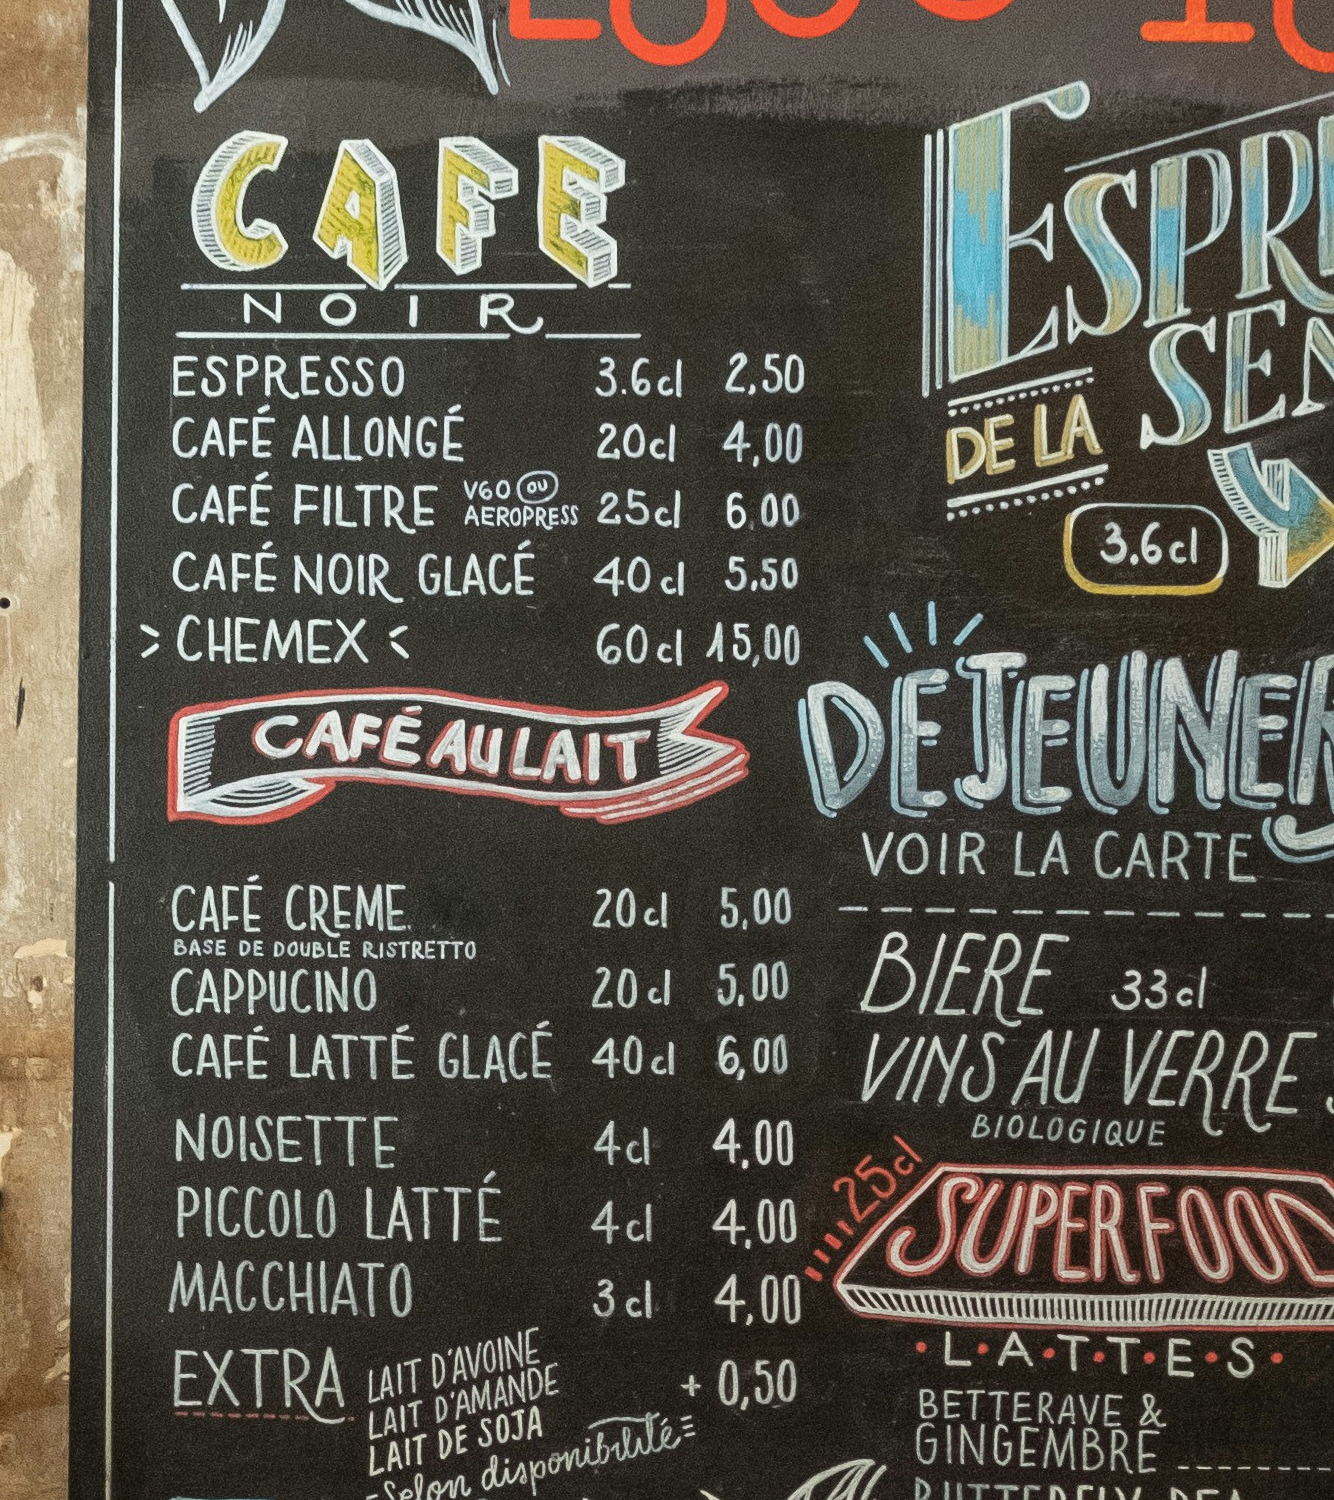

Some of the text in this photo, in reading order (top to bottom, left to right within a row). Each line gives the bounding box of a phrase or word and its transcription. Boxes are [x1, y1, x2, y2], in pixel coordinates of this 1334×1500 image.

[191, 130, 626, 289] CAFE
[243, 294, 542, 334] NOIR
[172, 355, 405, 398] ESPRESSO
[725, 353, 805, 395] 2,50
[172, 406, 274, 460] CAFÉ
[293, 404, 465, 462] ALLONGÉ
[723, 421, 803, 466] 4,00
[947, 413, 1015, 485] DE
[1034, 395, 1101, 464] LA
[172, 473, 437, 532] CAFÉ FILTRE
[465, 480, 510, 500] V60
[465, 505, 579, 529] AEROPRESS
[173, 541, 535, 602] CAFÉ NOIR GLACÉ
[178, 616, 800, 664] CHEMEX 15,00
[255, 706, 651, 784] CAFÉ AU LAIT
[863, 830, 1255, 882] VOIR LA CARTE
[171, 876, 263, 932] CAFÉ
[173, 939, 477, 959] BASE DE DOUBLE RISTRETTO
[171, 968, 377, 1015] CAPPUCINO
[861, 932, 1069, 1026] BIERE
[171, 1021, 789, 1082] CAFÉ LATTÉ GLACÉ 6,00
[862, 1030, 1317, 1135] VINS AU VERRE
[176, 1114, 398, 1168] NOISETTE
[972, 1115, 1165, 1146] BIOLOGIQUE
[176, 1171, 502, 1242] PICCOLO LATTÉ
[169, 1261, 412, 1318] MACCHIATO
[173, 1348, 345, 1423] EXTRA
[369, 1328, 540, 1404] LAIT D'AVOINE
[369, 1362, 560, 1440] LAIT D'AMANDE
[919, 1389, 1166, 1427] BETTERAVE &
[369, 1408, 543, 1476] LAIT DE SOJA
[481, 1409, 681, 1495] disponibilité
[916, 1423, 1160, 1473] GINGEMBRE
